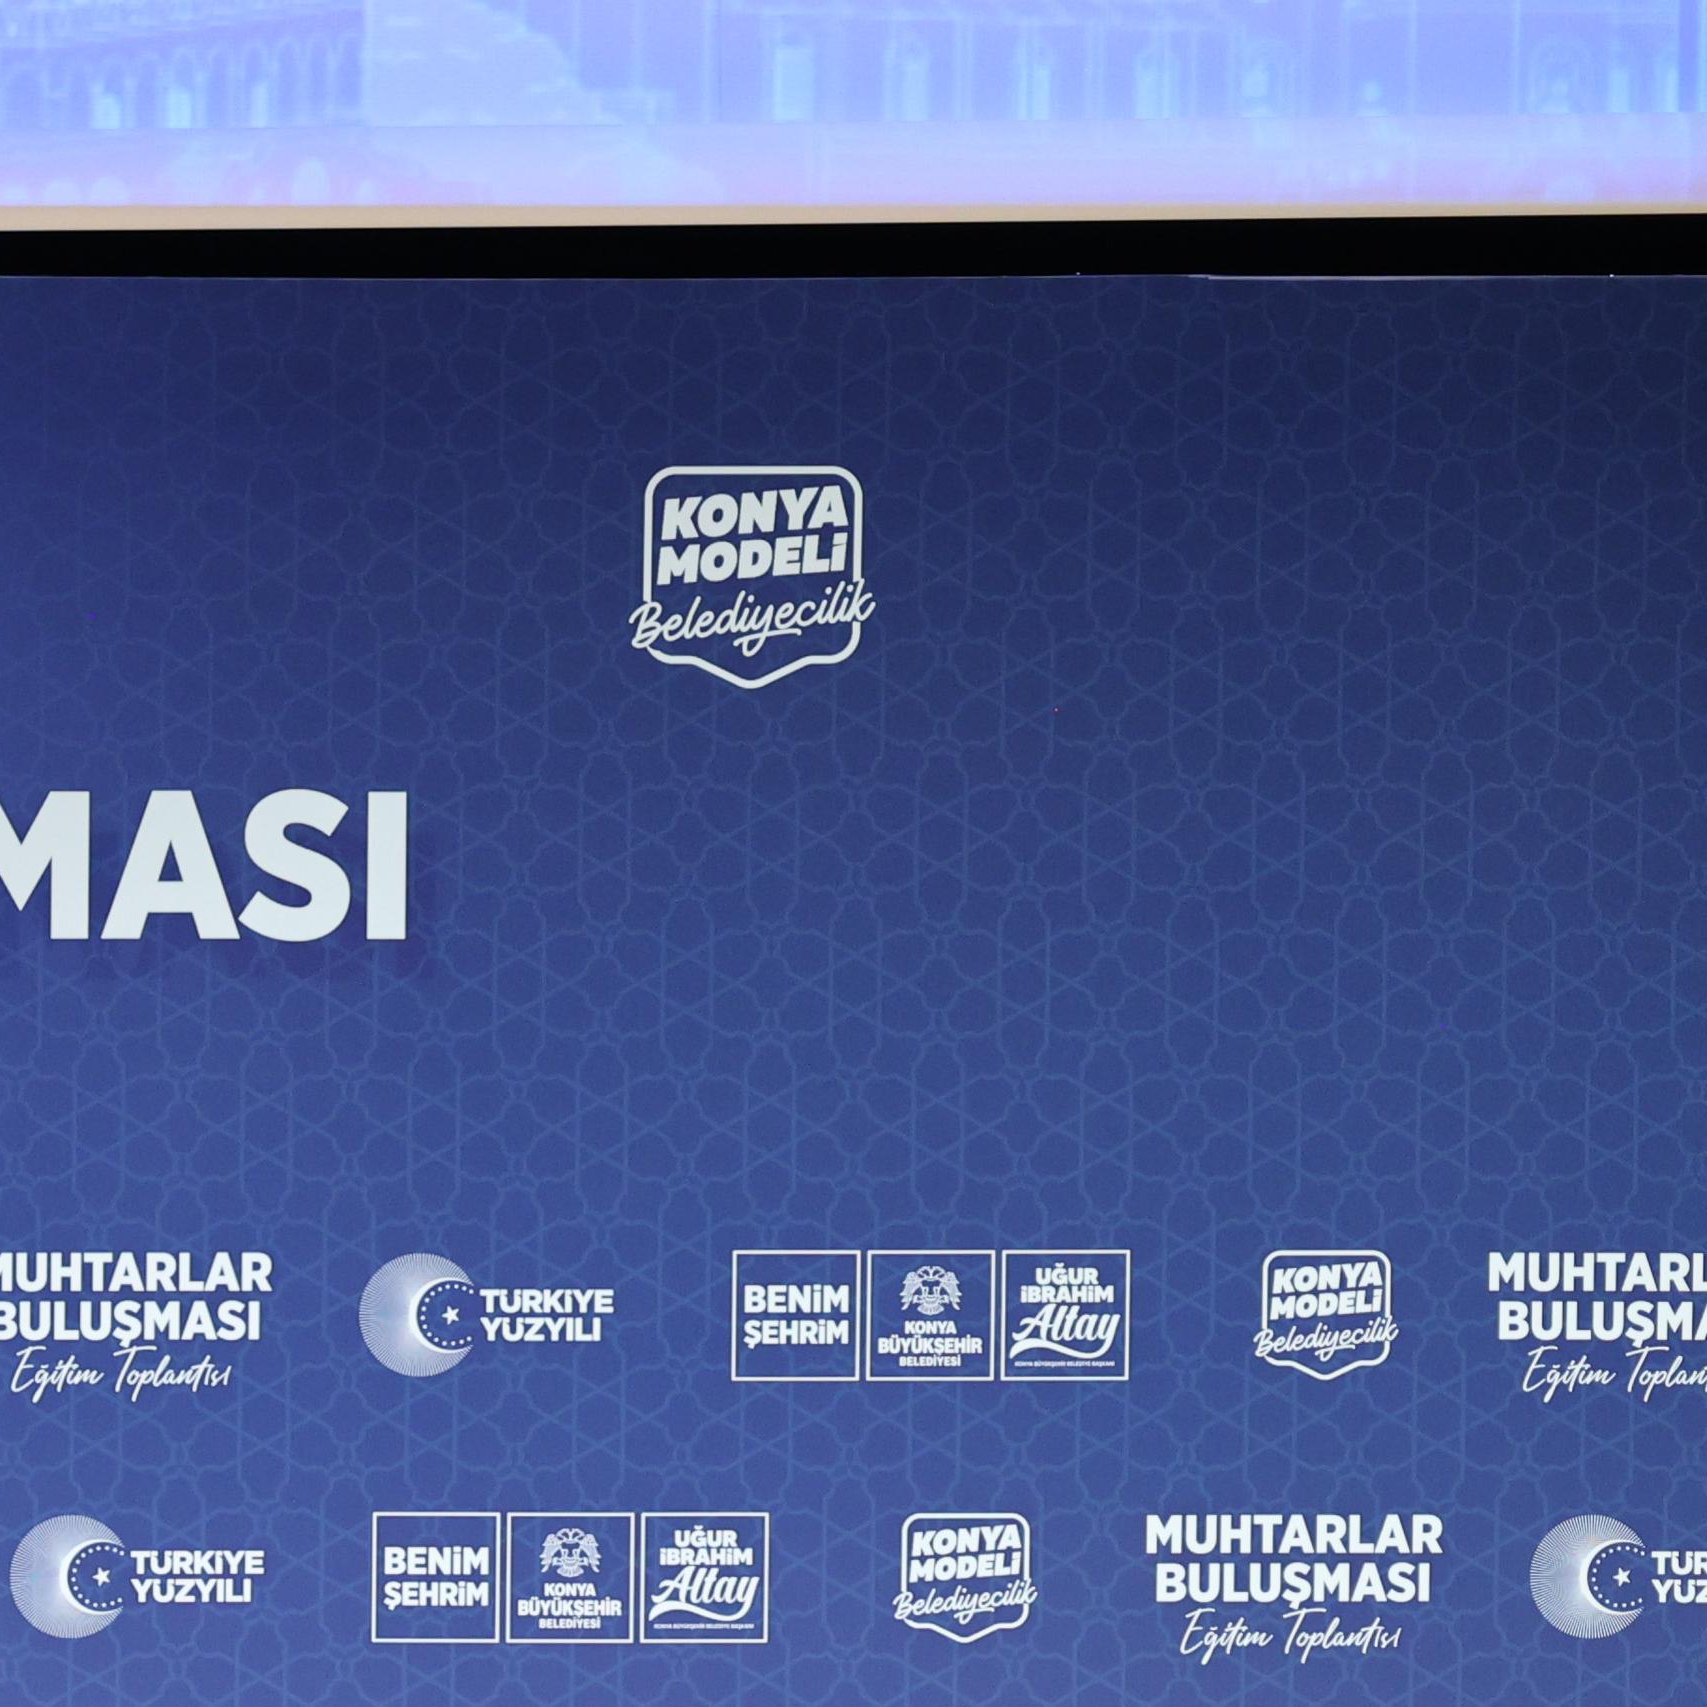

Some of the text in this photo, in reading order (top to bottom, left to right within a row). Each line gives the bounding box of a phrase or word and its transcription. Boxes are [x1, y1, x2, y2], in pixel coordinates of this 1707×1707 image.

[661, 486, 849, 541] KONYA
[657, 532, 848, 586] MODELİ
[629, 578, 877, 657] Belediyecilik
[12, 1345, 232, 1404] Eğitim Toplantısı
[673, 1526, 736, 1548] UĞUR
[911, 1525, 1022, 1557] KONYA
[1145, 1514, 1442, 1555] MUHTARLAR
[384, 1546, 489, 1576] BENİM
[909, 1552, 1022, 1583] MODELİ
[384, 1581, 489, 1611] ŞEHRİM
[517, 1596, 623, 1619] BÜYÜKŞEHİR
[544, 1582, 596, 1597] KONYA
[648, 1566, 759, 1622] Altay
[894, 1578, 1039, 1626] Belediyecilik
[1155, 1563, 1430, 1611] BULUŞMASI
[539, 1616, 601, 1629] BELEDİYESİ
[1181, 1607, 1403, 1666] Eğitim Toplantısı
